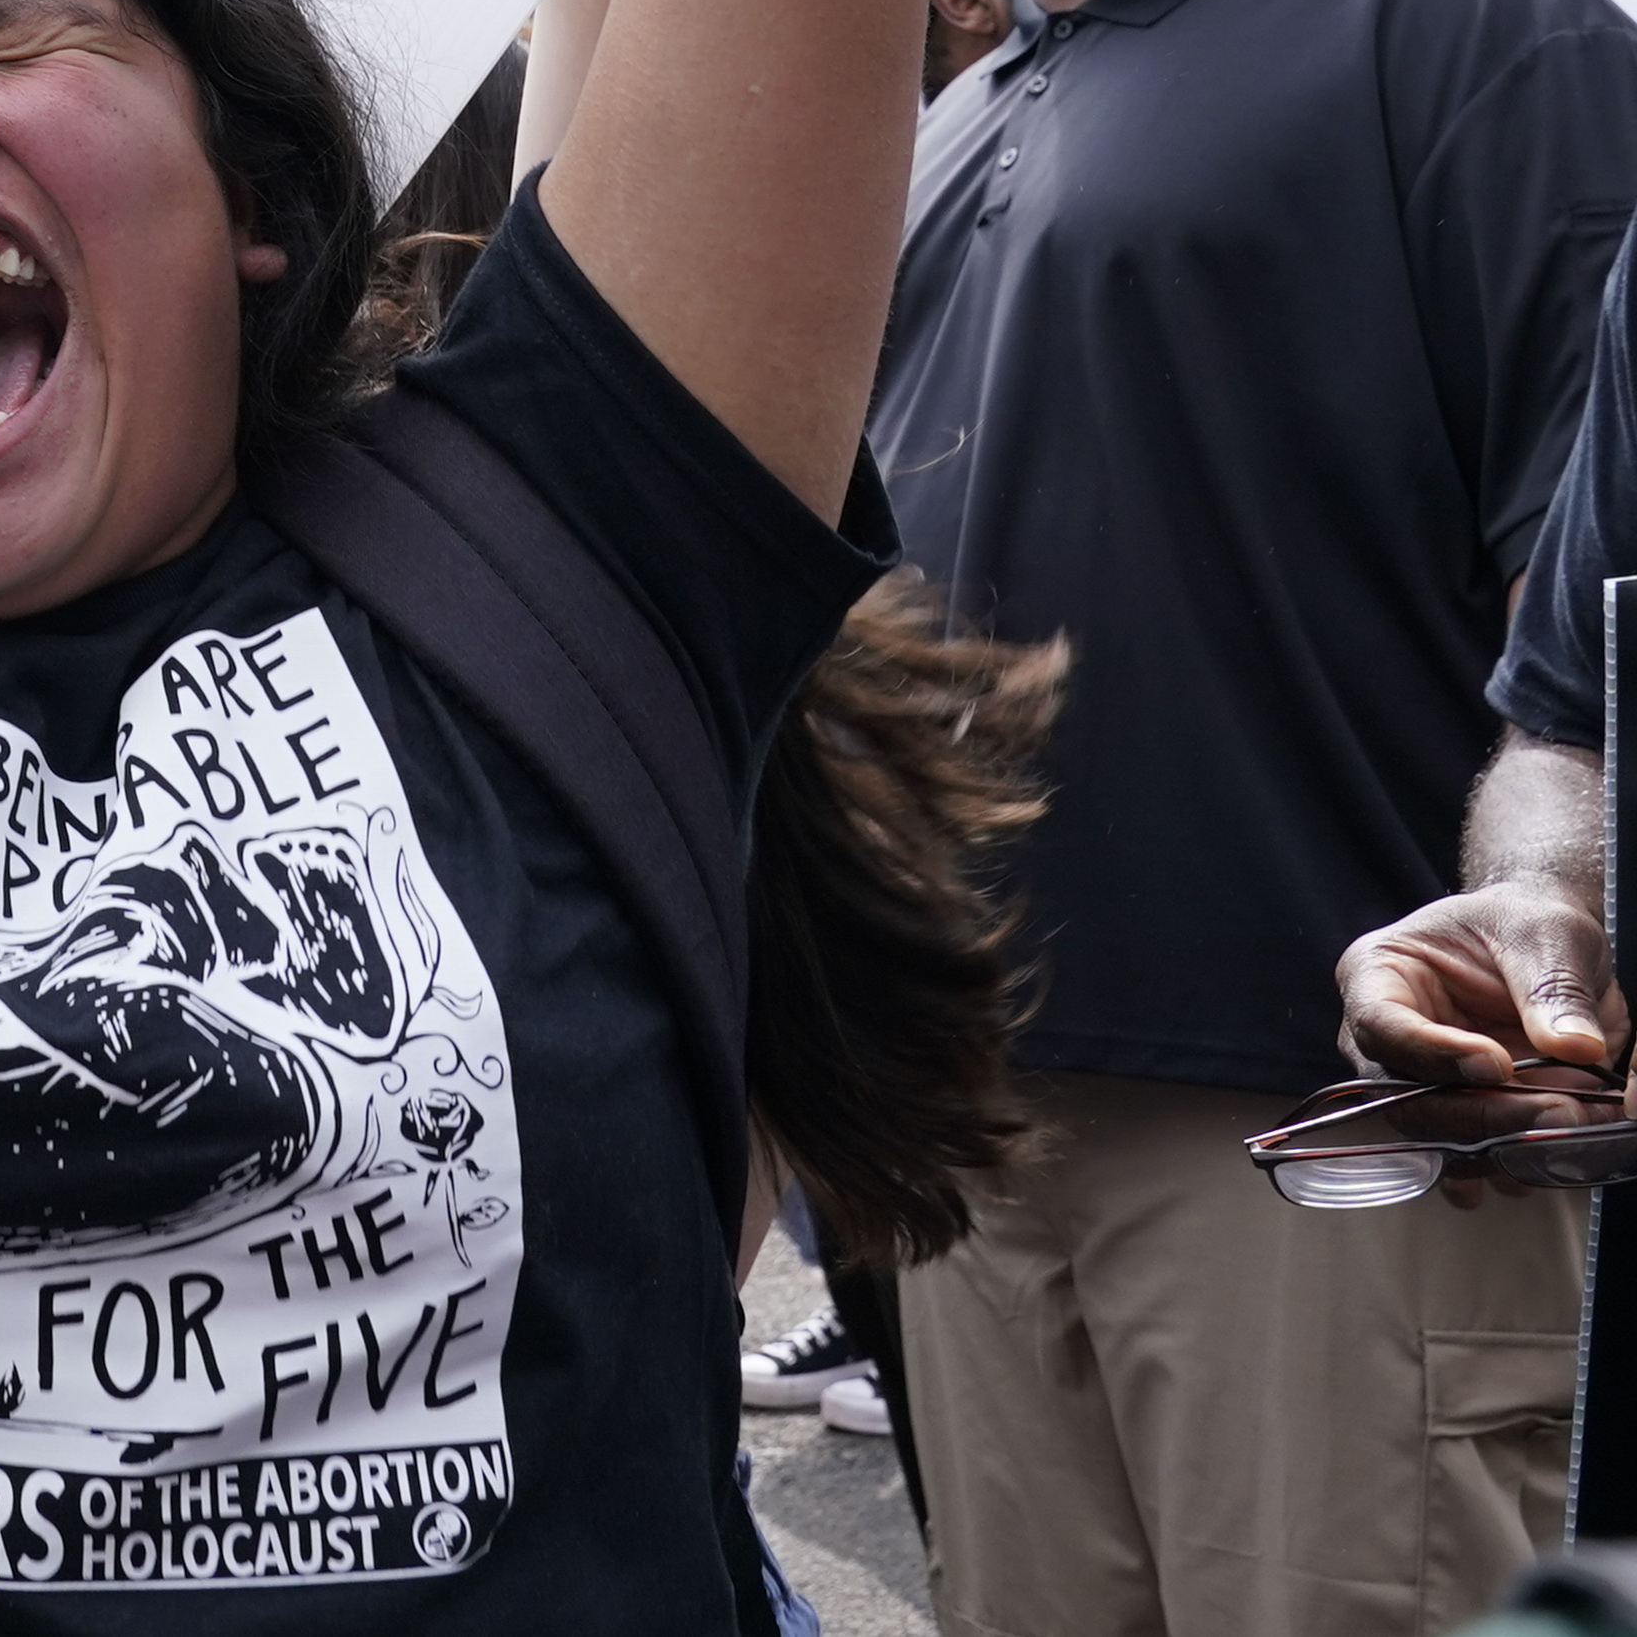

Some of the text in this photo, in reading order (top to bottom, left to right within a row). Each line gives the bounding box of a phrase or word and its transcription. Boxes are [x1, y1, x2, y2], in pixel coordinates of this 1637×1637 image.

[161, 629, 315, 717] ARE
[37, 1271, 226, 1400] FOR
[249, 1192, 415, 1302] THE
[261, 1277, 487, 1443] FIVE
[81, 1478, 146, 1526] OF
[155, 1469, 242, 1522] THE
[253, 1441, 509, 1520] ABORTION
[83, 1516, 381, 1580] HOLOCAUST
